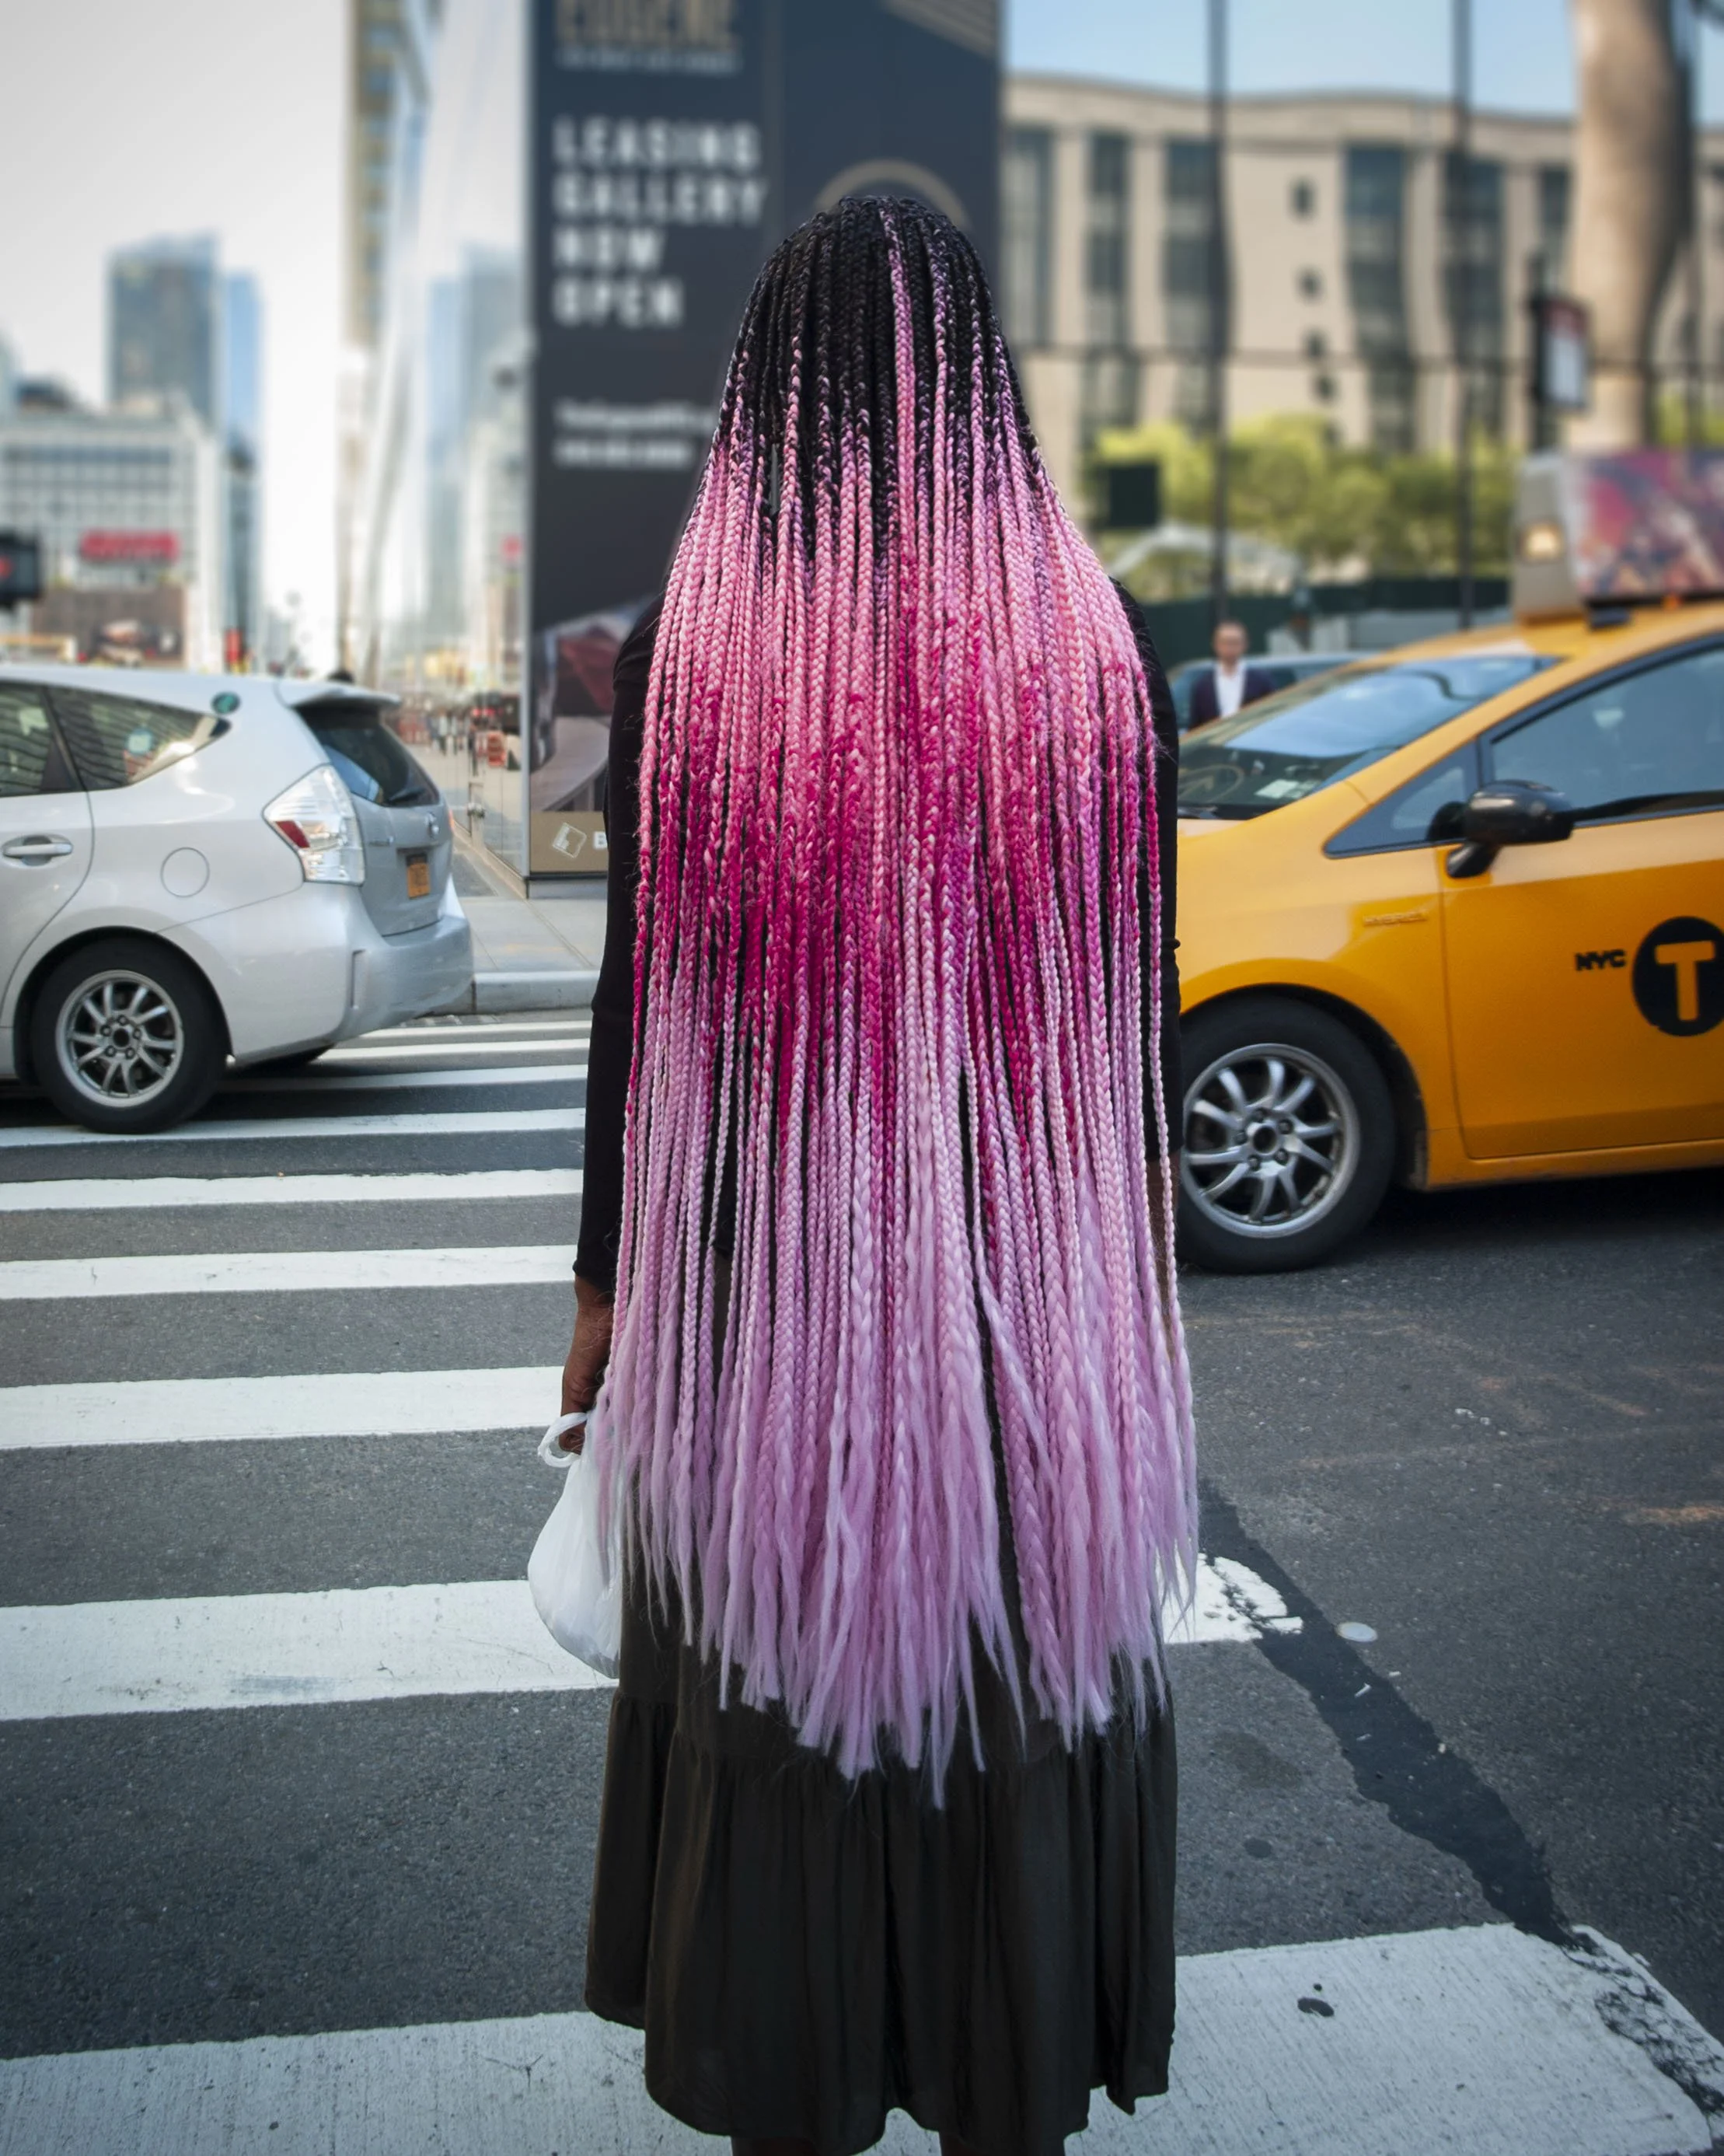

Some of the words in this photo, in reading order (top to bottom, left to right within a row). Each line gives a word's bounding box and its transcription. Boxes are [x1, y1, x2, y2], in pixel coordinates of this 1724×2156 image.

[553, 118, 759, 168] LEASING
[553, 172, 767, 223] GALLERY
[553, 227, 663, 269] NOW
[553, 278, 681, 325] OPEN
[1575, 949, 1627, 970] NYC
[1656, 940, 1715, 1022] T
